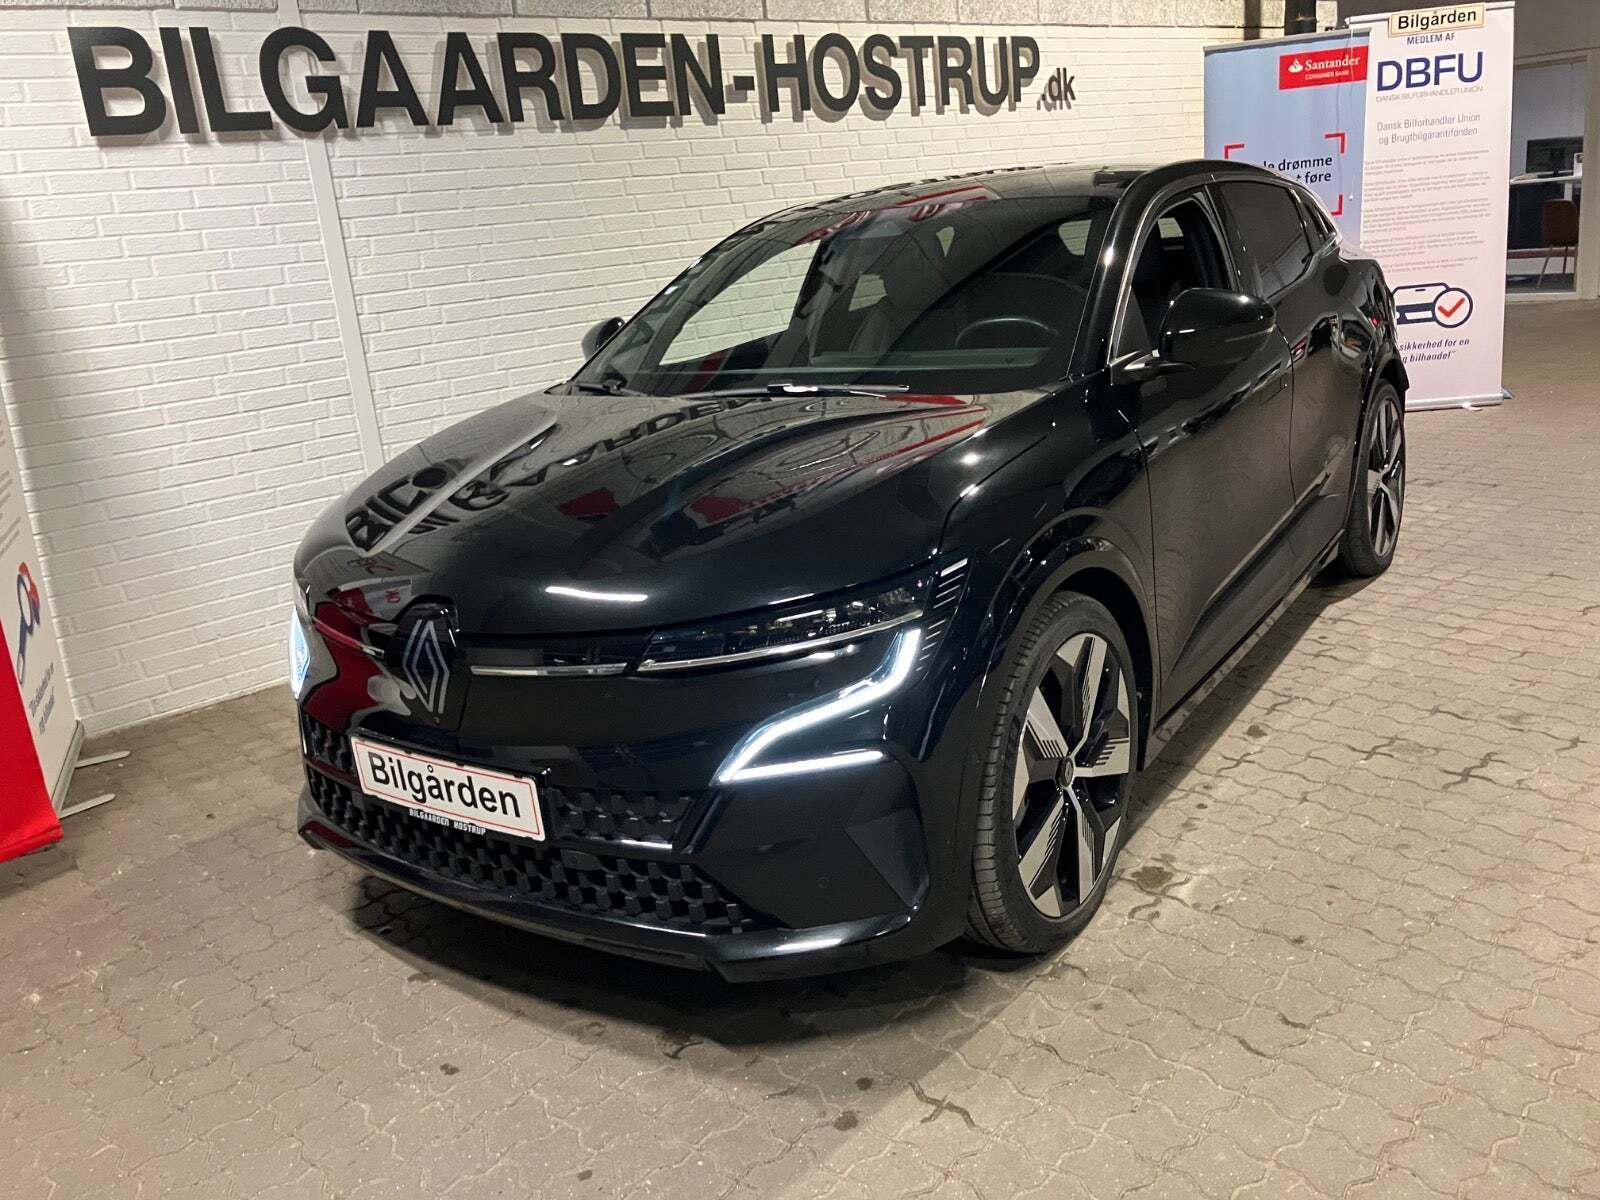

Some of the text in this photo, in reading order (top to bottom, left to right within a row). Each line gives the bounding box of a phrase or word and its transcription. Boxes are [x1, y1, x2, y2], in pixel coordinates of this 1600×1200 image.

[1398, 10, 1477, 30] Bilgården
[1406, 32, 1456, 45] MEDLEM AF
[1305, 55, 1360, 71] Santander
[1376, 51, 1484, 92] DBFU
[1376, 113, 1481, 132] Dansk Bilforhandler Union
[1378, 127, 1478, 146] og Brugtbilgarantifonden
[1278, 156, 1333, 171] drømme
[1304, 171, 1332, 184] føre
[1399, 337, 1470, 351] sikkerhed for en
[367, 751, 521, 818] Bilgården
[408, 808, 487, 836] BILGAARDEN HOSTRUP
